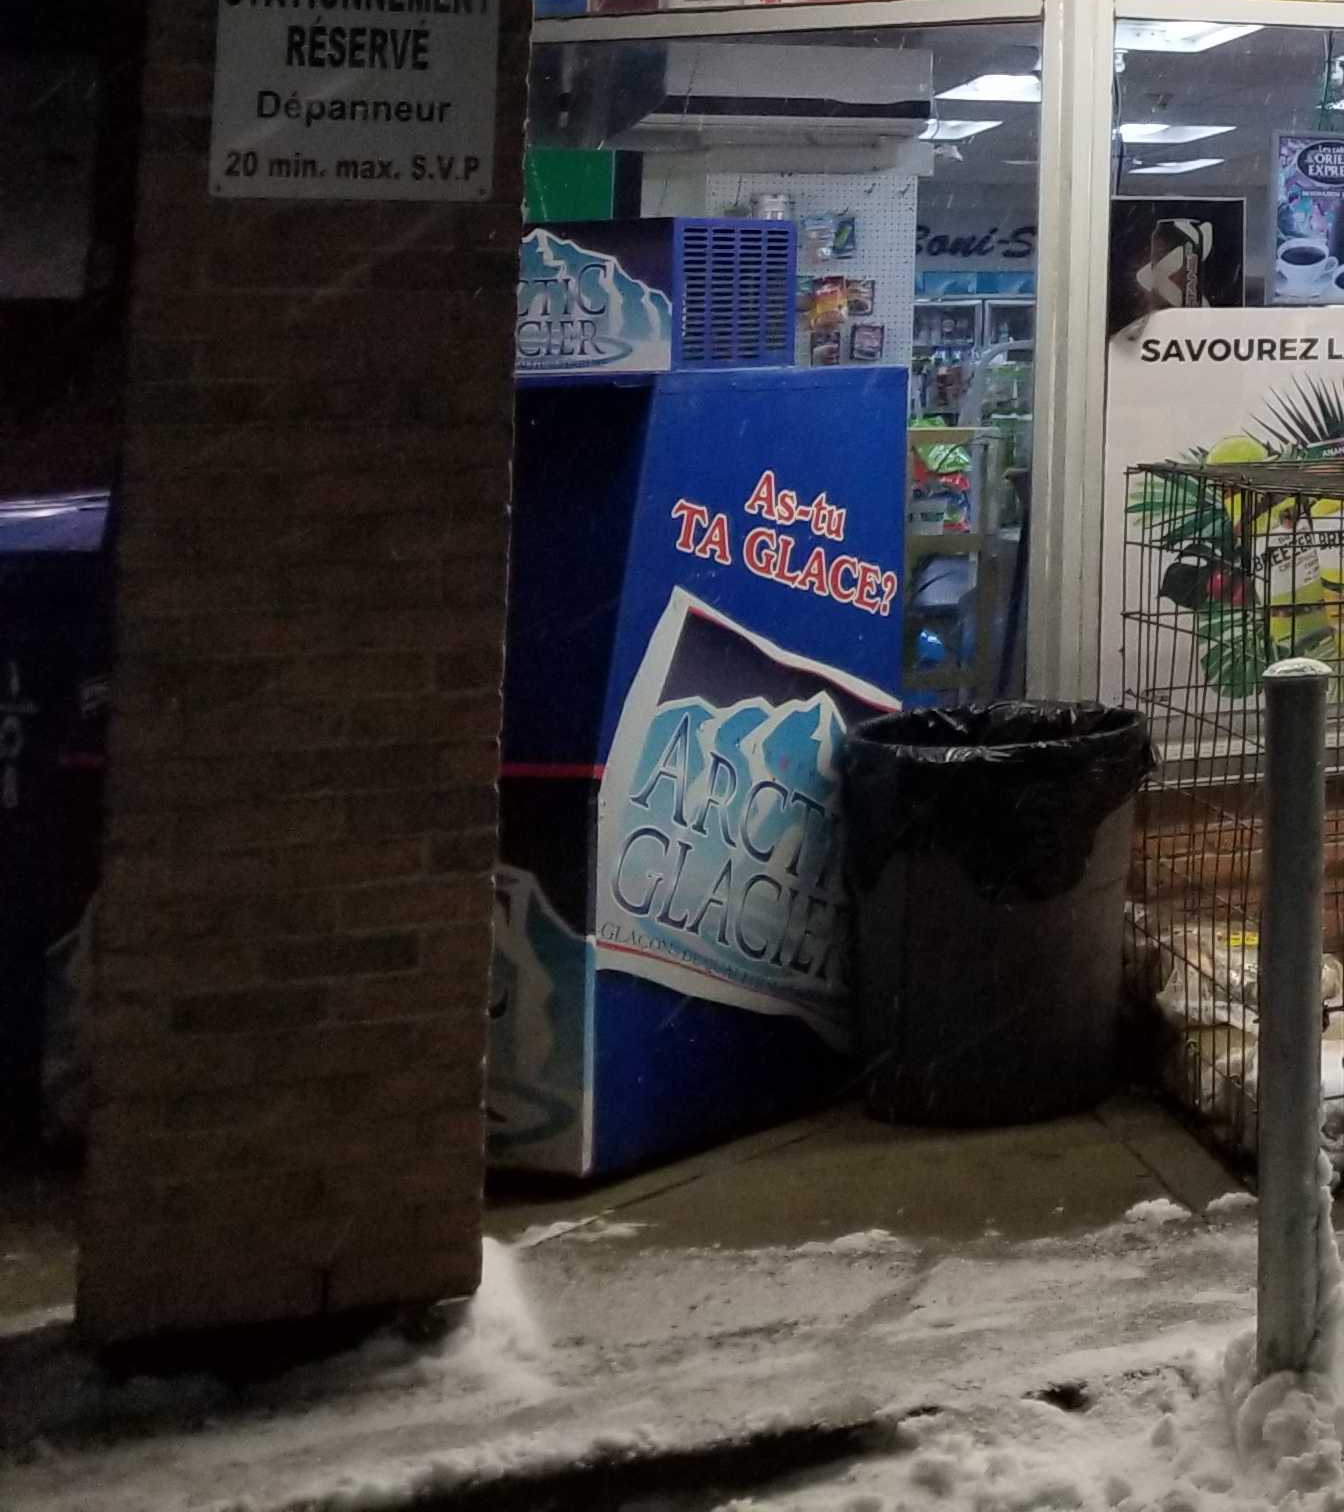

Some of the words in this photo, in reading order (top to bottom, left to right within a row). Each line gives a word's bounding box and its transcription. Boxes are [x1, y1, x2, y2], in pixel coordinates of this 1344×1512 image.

[286, 17, 430, 70] RÉSERVÉ
[257, 90, 451, 126] Dépanneur
[225, 151, 259, 177] 20
[268, 154, 325, 178] min.
[336, 157, 399, 181] max.
[412, 155, 480, 182] S.V.P
[1140, 336, 1319, 362] SAVOUREZ
[745, 471, 847, 542] As-tu
[672, 500, 731, 566] TA
[743, 528, 897, 616] GLACE?
